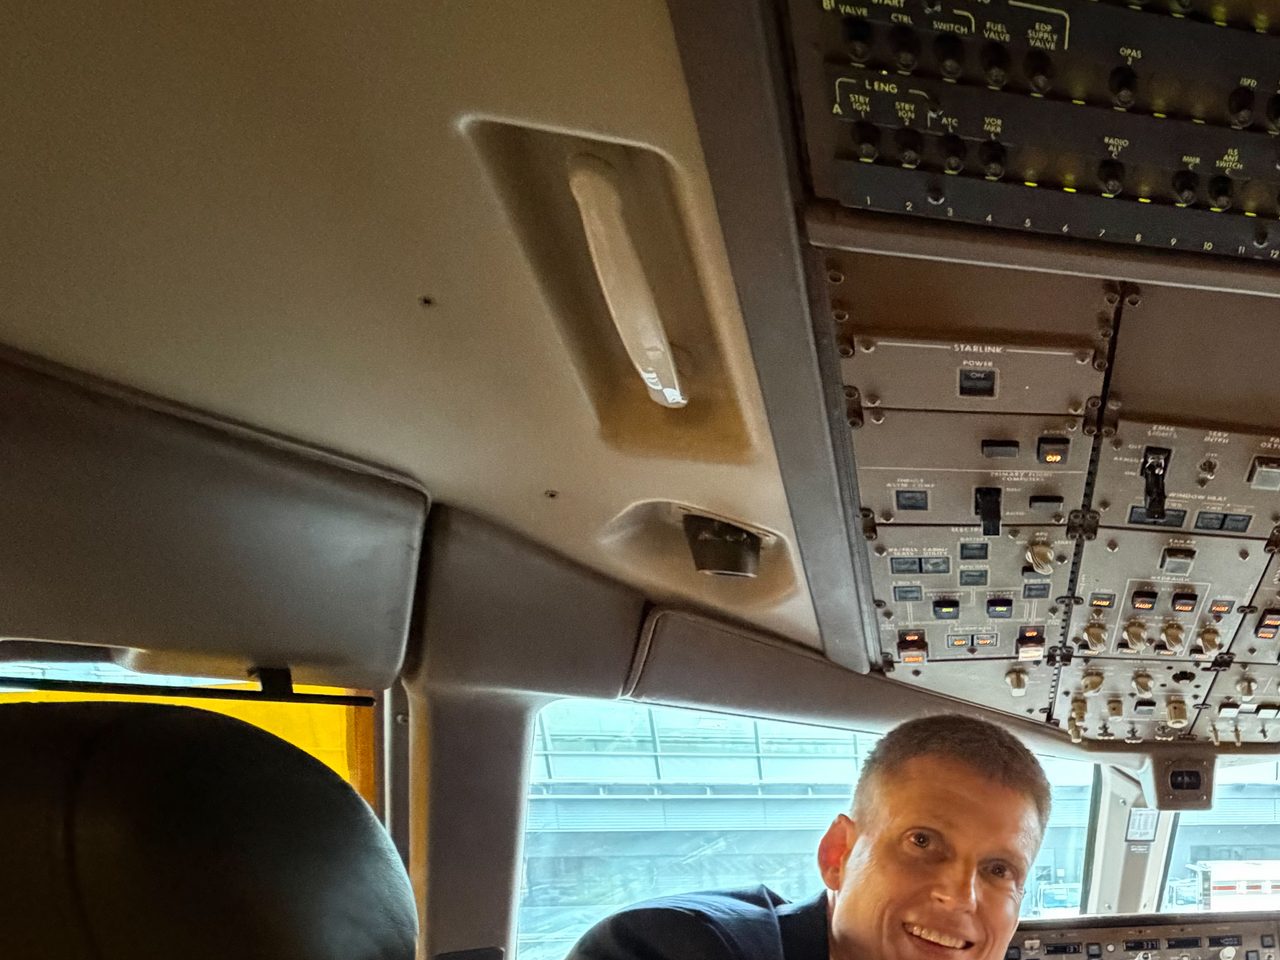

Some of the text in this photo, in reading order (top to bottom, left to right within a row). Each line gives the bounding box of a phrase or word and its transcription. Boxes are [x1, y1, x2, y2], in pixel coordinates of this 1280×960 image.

[839, 4, 868, 17] VALVE
[933, 21, 968, 34] SWITCH
[985, 21, 1006, 33] FUEL
[983, 29, 1010, 43] VALVE
[874, 81, 897, 94] ENG
[850, 94, 870, 105] STBY
[832, 104, 842, 115] A
[895, 101, 915, 112] STBY
[941, 117, 958, 128] ATC
[1104, 136, 1129, 148] RADIO
[1215, 160, 1243, 171] SWITCH
[953, 344, 1003, 353] STARLINK
[962, 359, 993, 368] POWER
